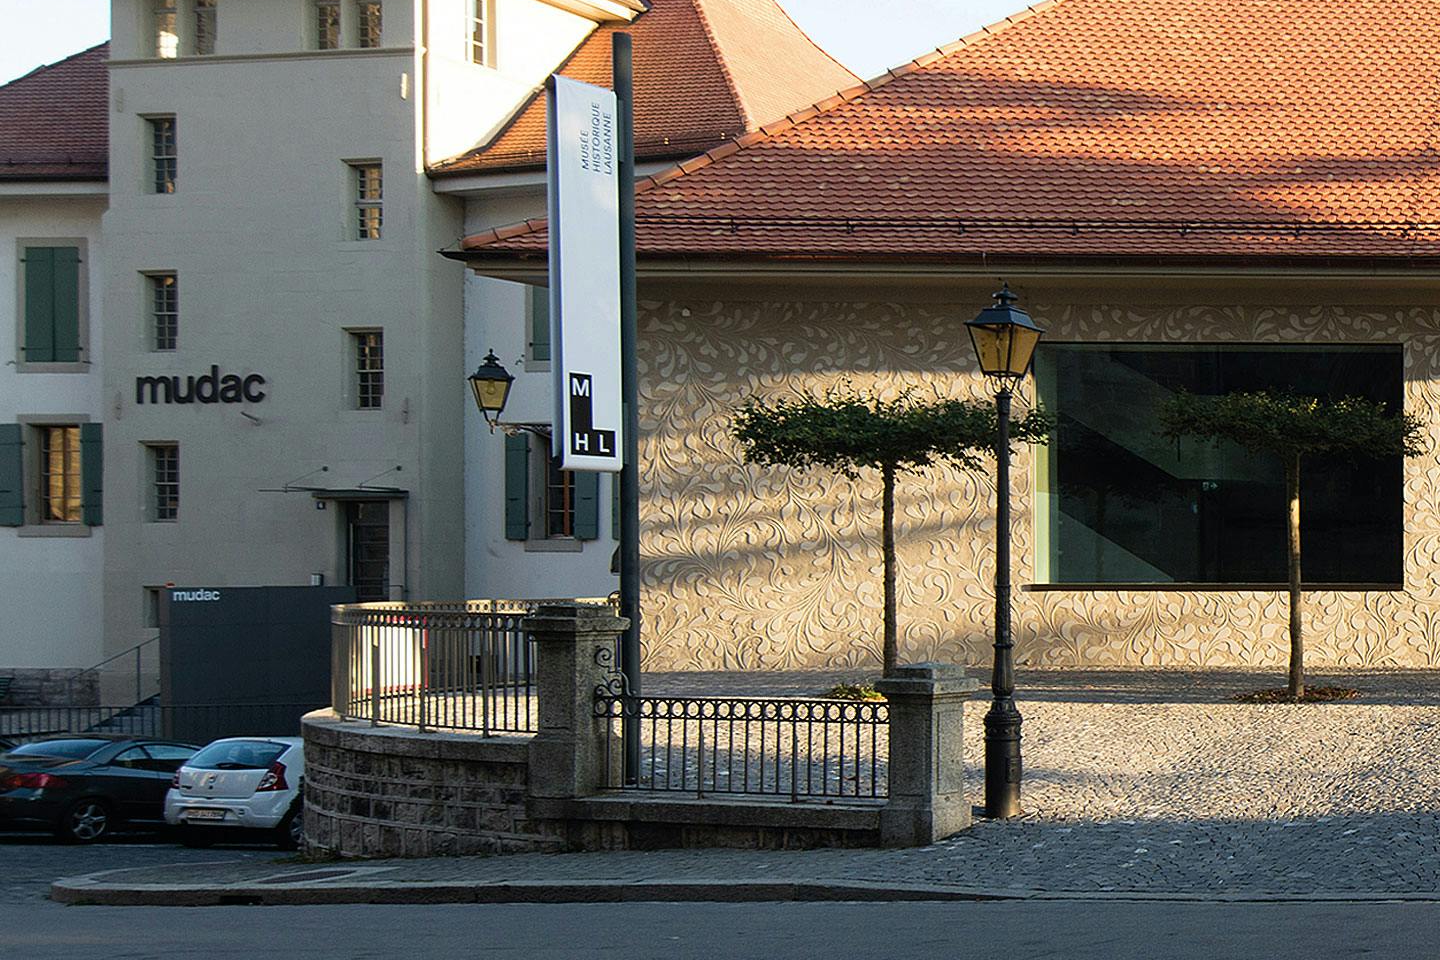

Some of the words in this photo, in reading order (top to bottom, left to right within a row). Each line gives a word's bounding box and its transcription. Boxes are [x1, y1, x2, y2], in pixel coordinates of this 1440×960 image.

[579, 130, 589, 170] MUSÉE
[591, 102, 601, 173] HISTORIQUE
[602, 112, 612, 175] LAUSANNE
[136, 364, 266, 404] mudac
[572, 377, 590, 398] M
[173, 589, 220, 601] mudac
